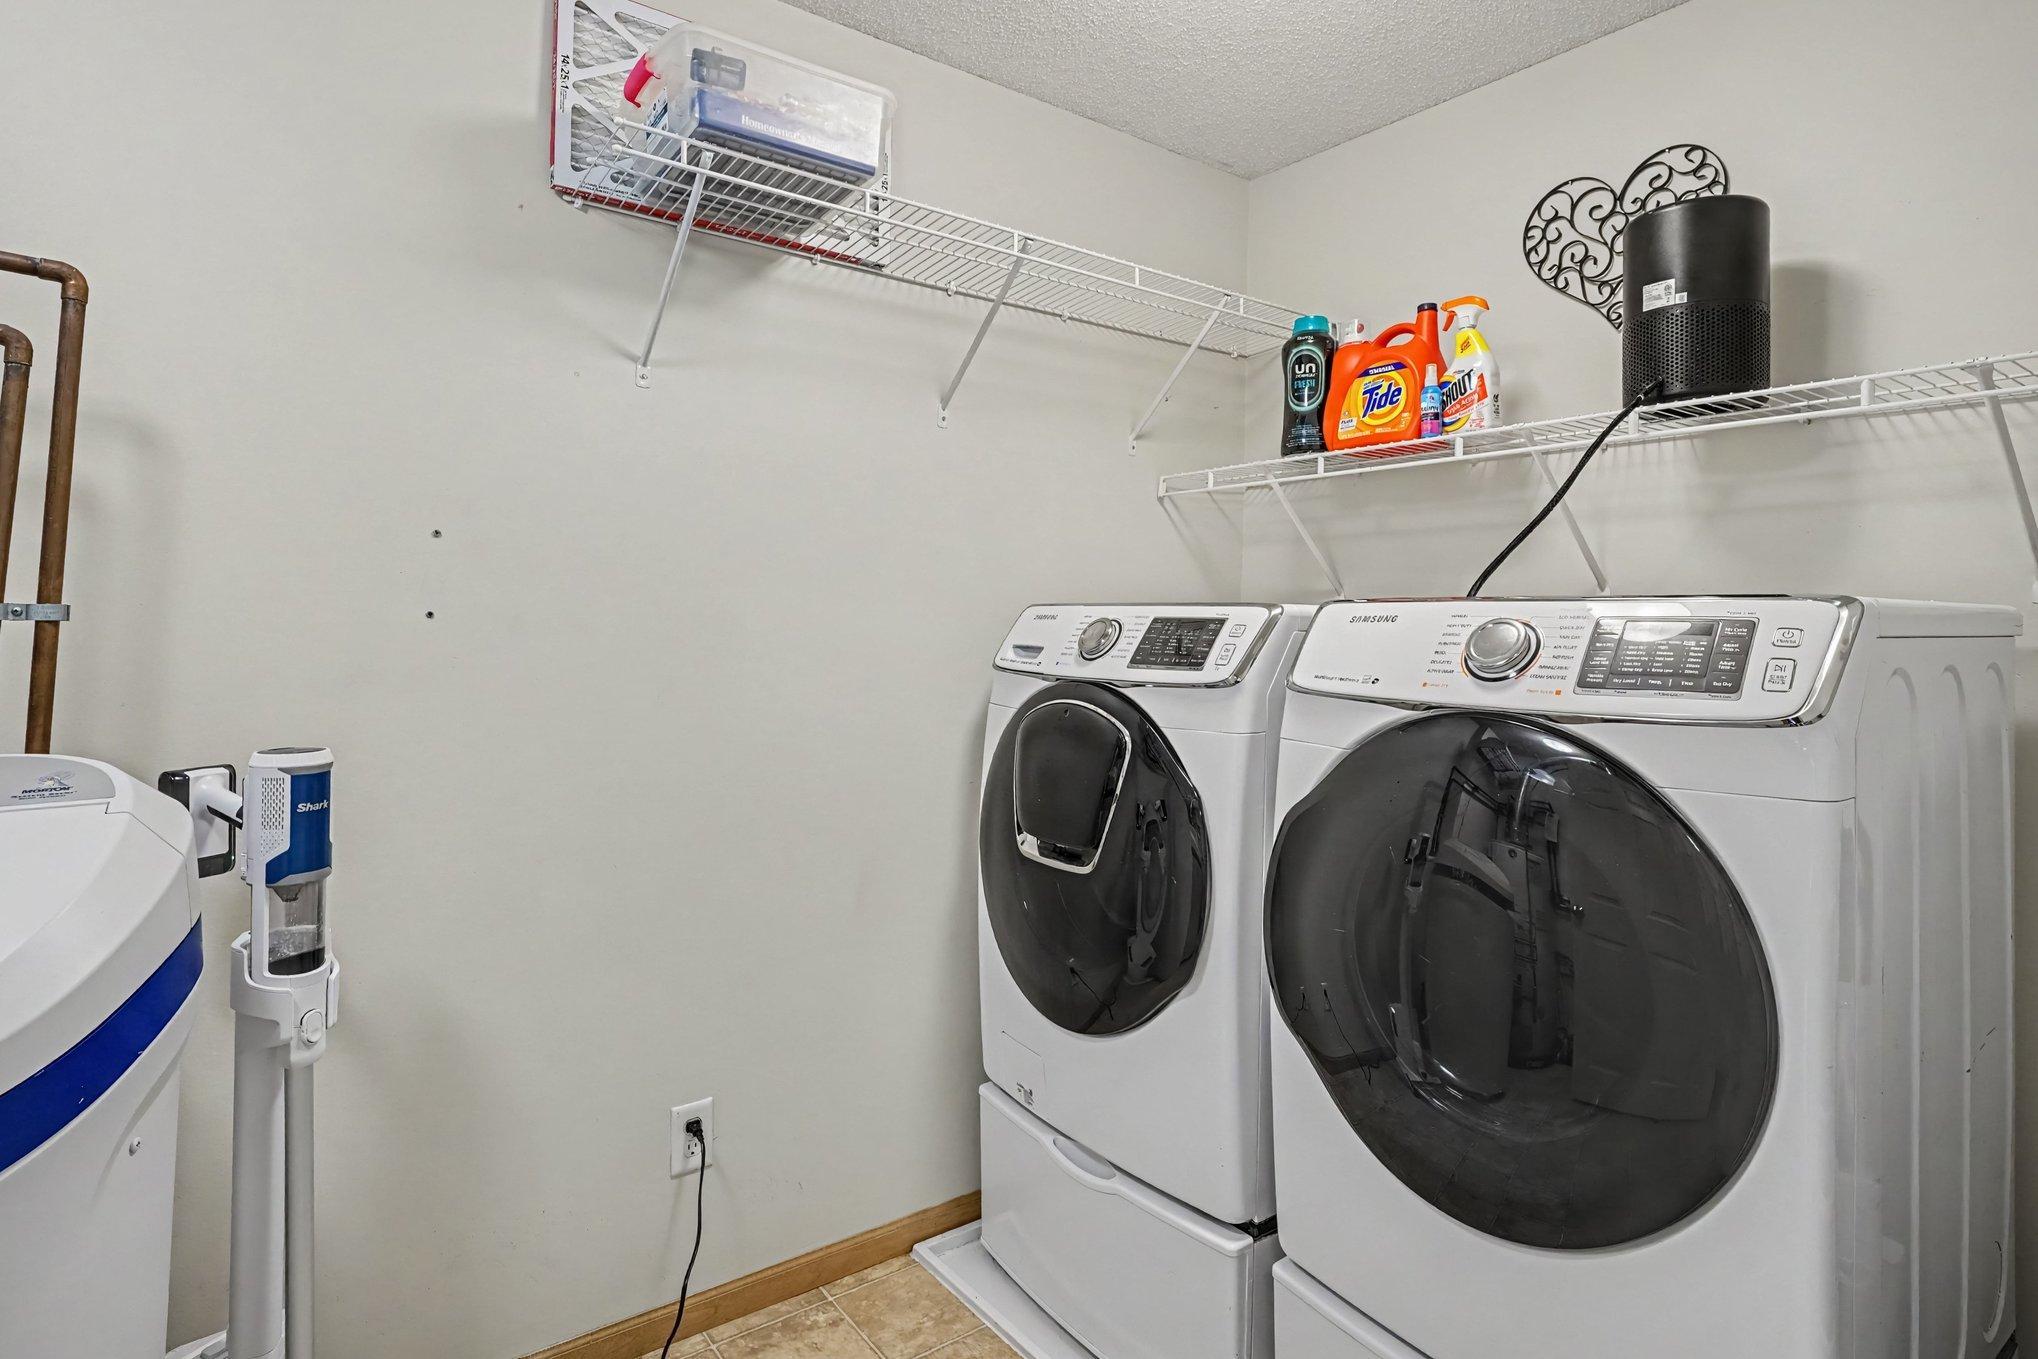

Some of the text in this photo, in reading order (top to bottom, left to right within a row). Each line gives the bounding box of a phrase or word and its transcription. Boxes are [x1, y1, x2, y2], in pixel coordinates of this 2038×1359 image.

[1362, 382, 1402, 418] Tide
[1349, 615, 1399, 623] SAMSUNG
[296, 799, 329, 813] Shark
